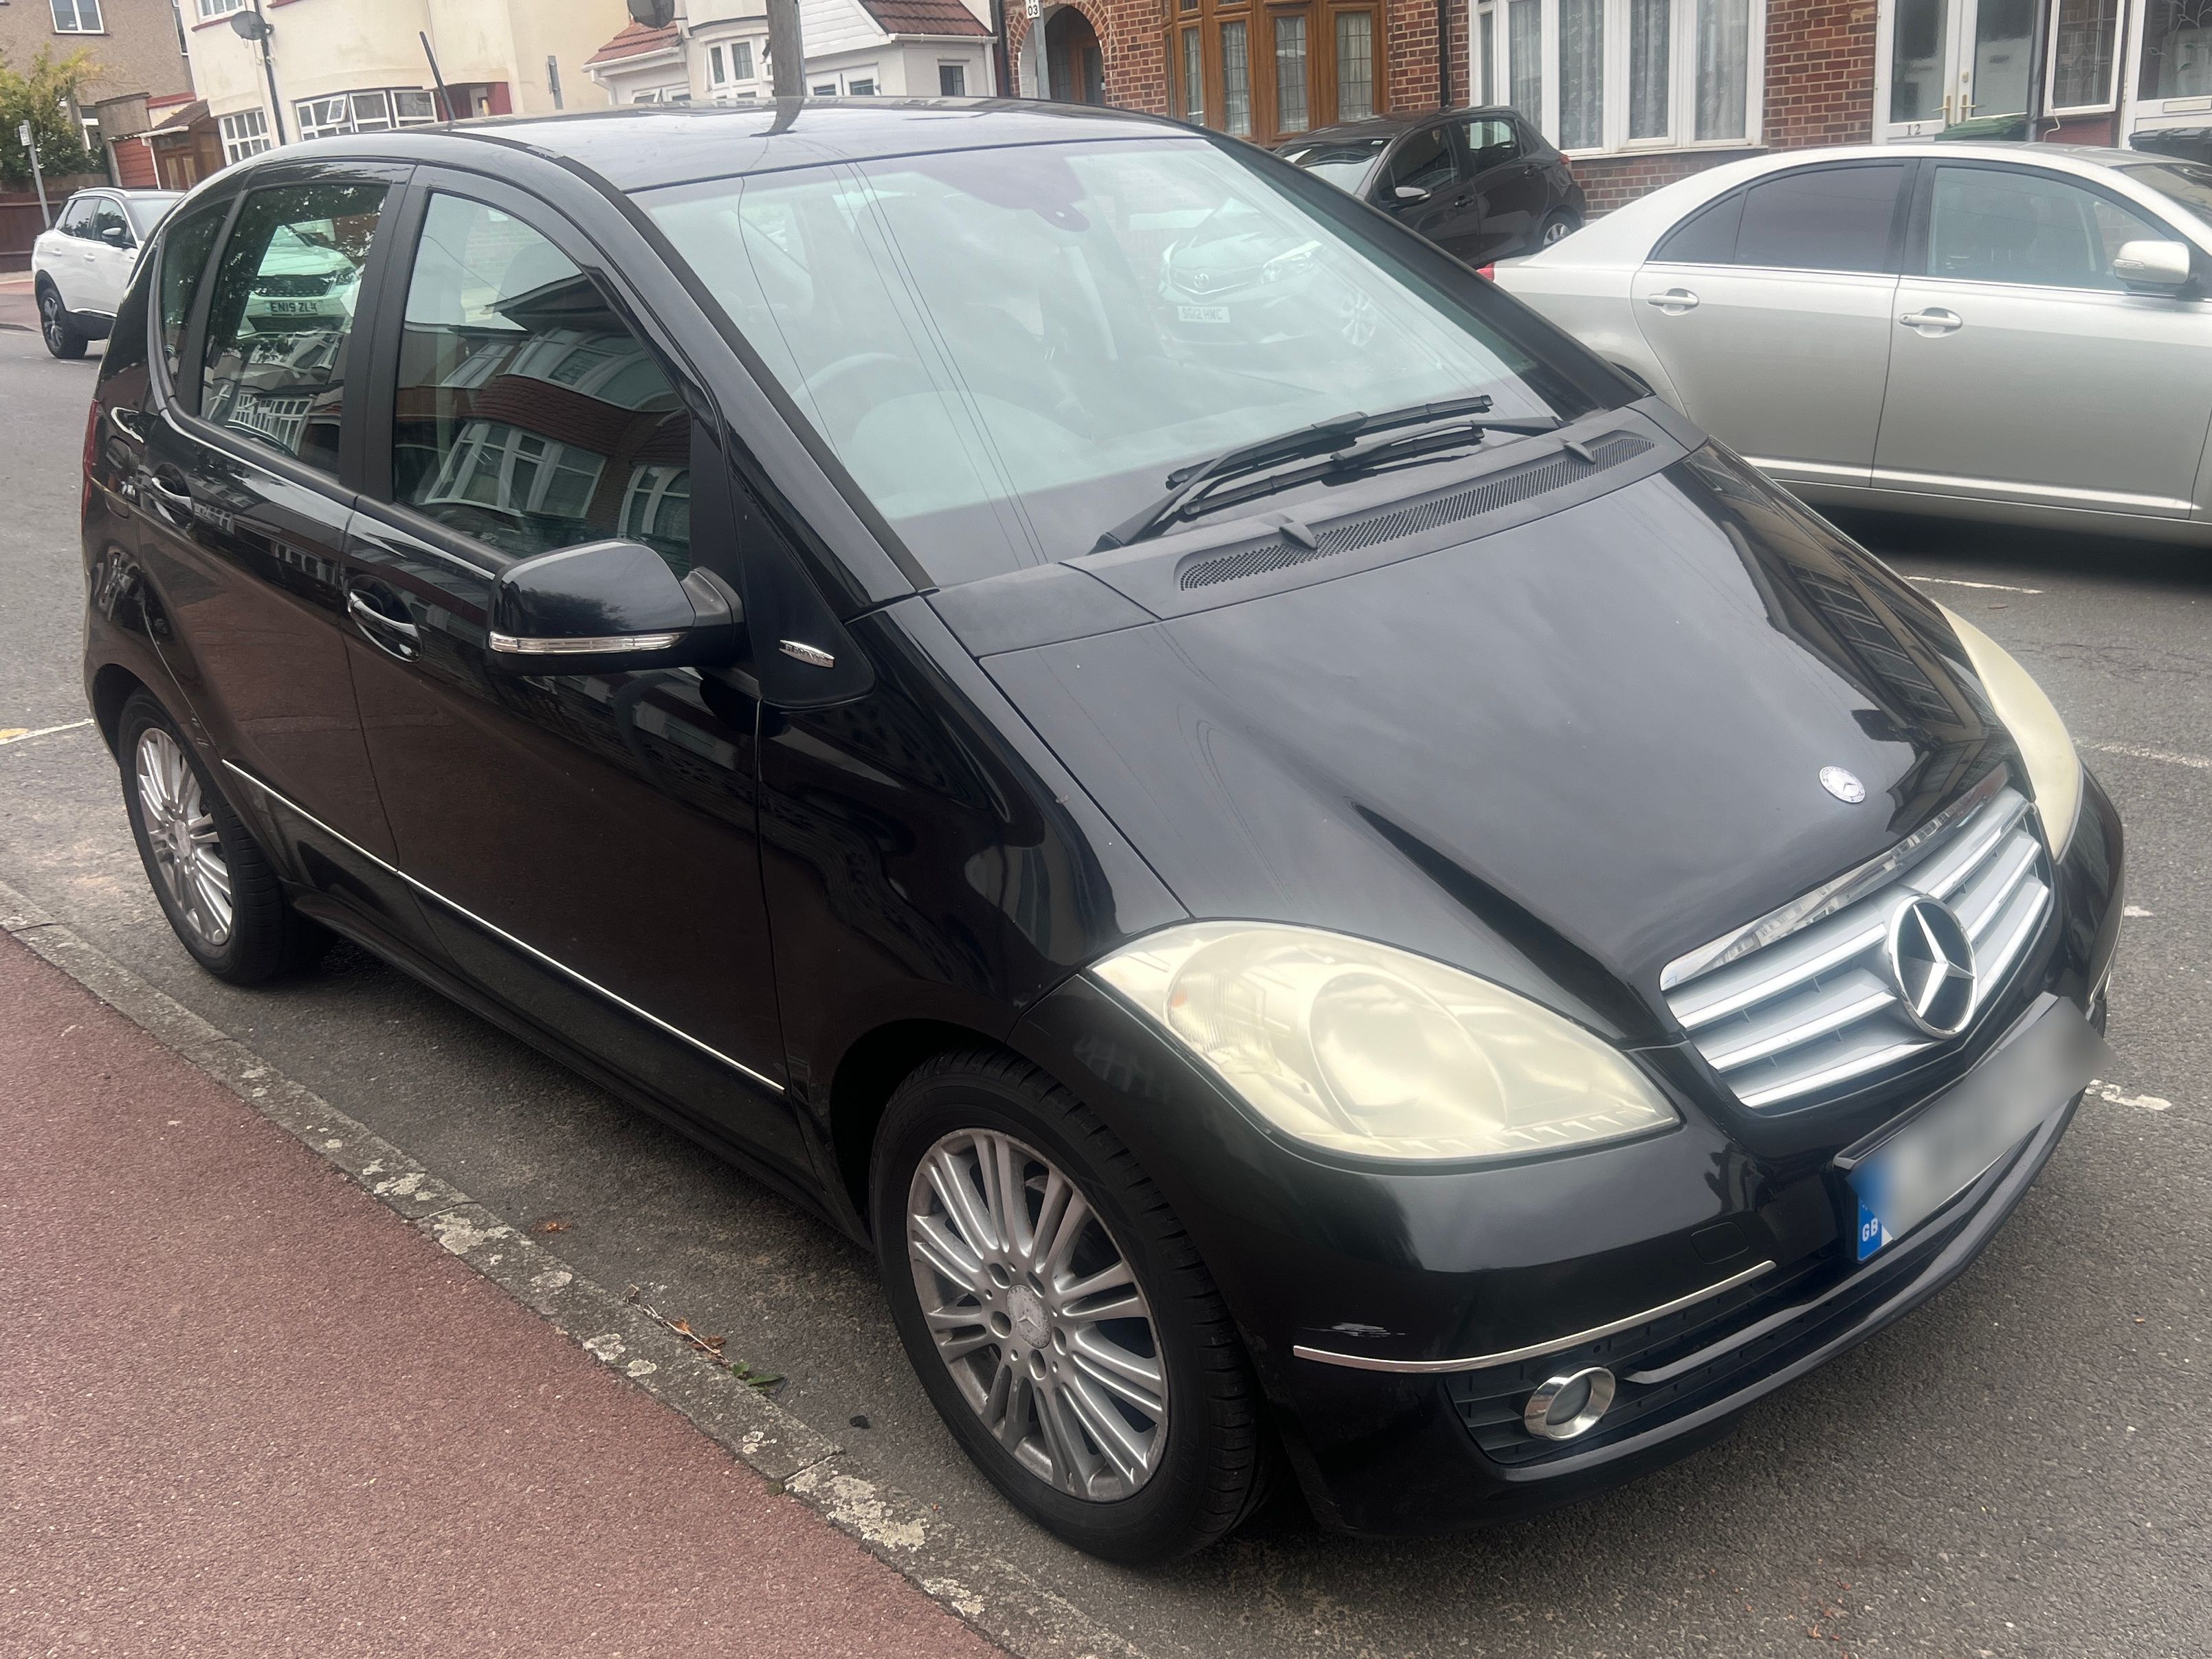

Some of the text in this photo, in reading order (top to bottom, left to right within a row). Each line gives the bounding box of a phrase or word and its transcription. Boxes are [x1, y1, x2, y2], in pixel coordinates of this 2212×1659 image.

[1028, 4, 1038, 16] 03
[1906, 124, 1921, 135] 12
[1862, 1218, 1878, 1242] GB
